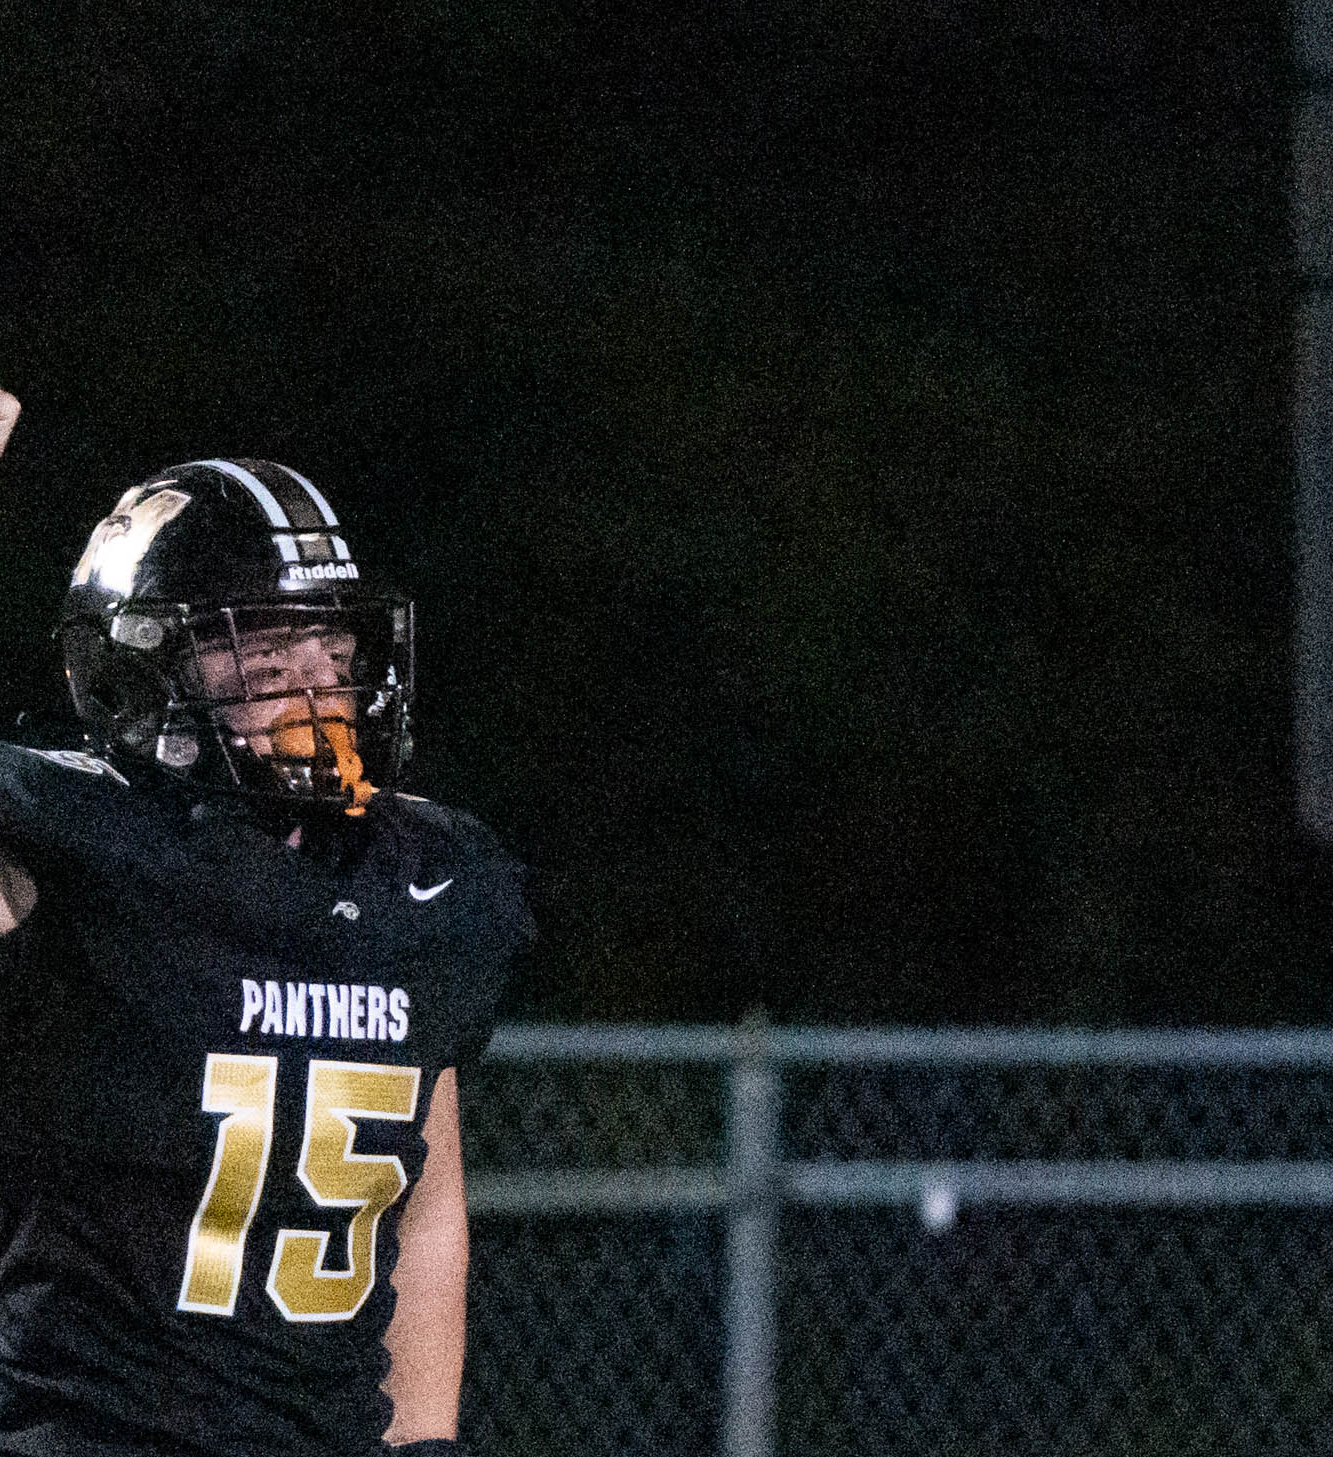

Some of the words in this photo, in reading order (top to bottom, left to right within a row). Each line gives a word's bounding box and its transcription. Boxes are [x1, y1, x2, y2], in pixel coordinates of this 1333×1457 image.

[287, 562, 359, 579] Riddell
[240, 979, 410, 1041] PANTHERS
[177, 1053, 421, 1322] 15
